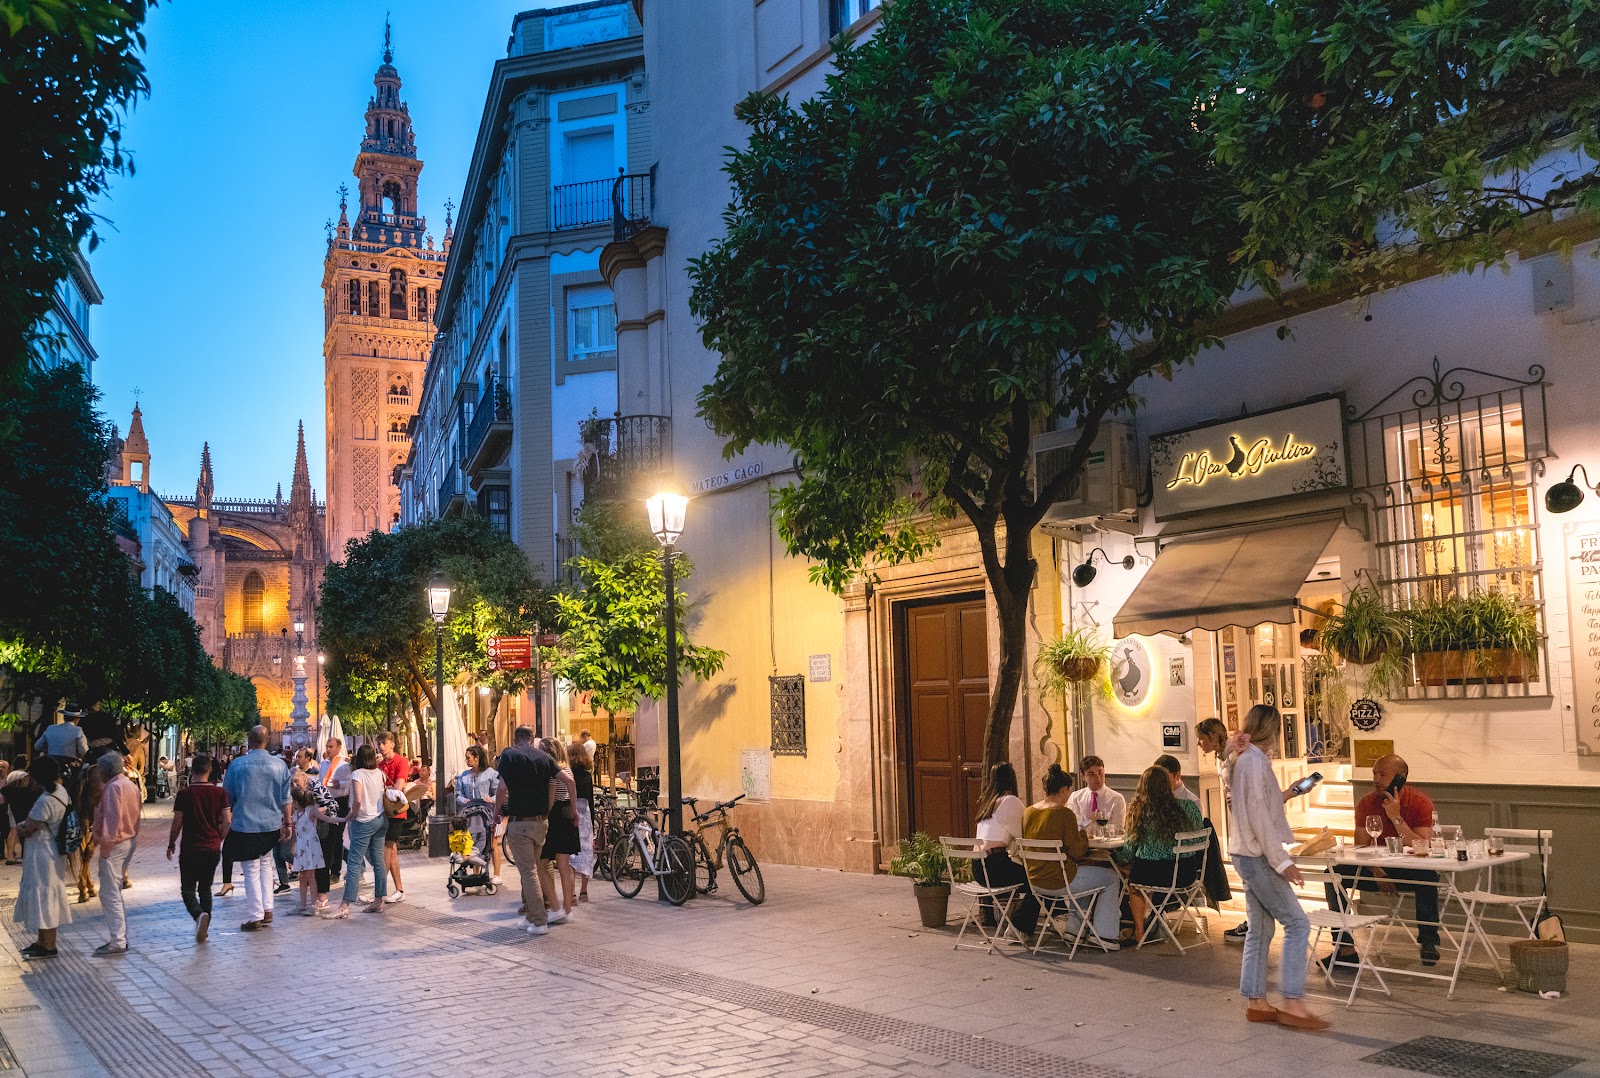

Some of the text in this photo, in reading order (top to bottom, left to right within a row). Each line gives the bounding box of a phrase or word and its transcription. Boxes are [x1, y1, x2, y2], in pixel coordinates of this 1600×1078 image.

[1165, 434, 1314, 489] L'Oca Giuliva
[692, 463, 761, 491] MATEOS GAGO
[1580, 537, 1600, 549] FR
[1580, 565, 1600, 576] PA
[1351, 709, 1380, 718] PIZZA
